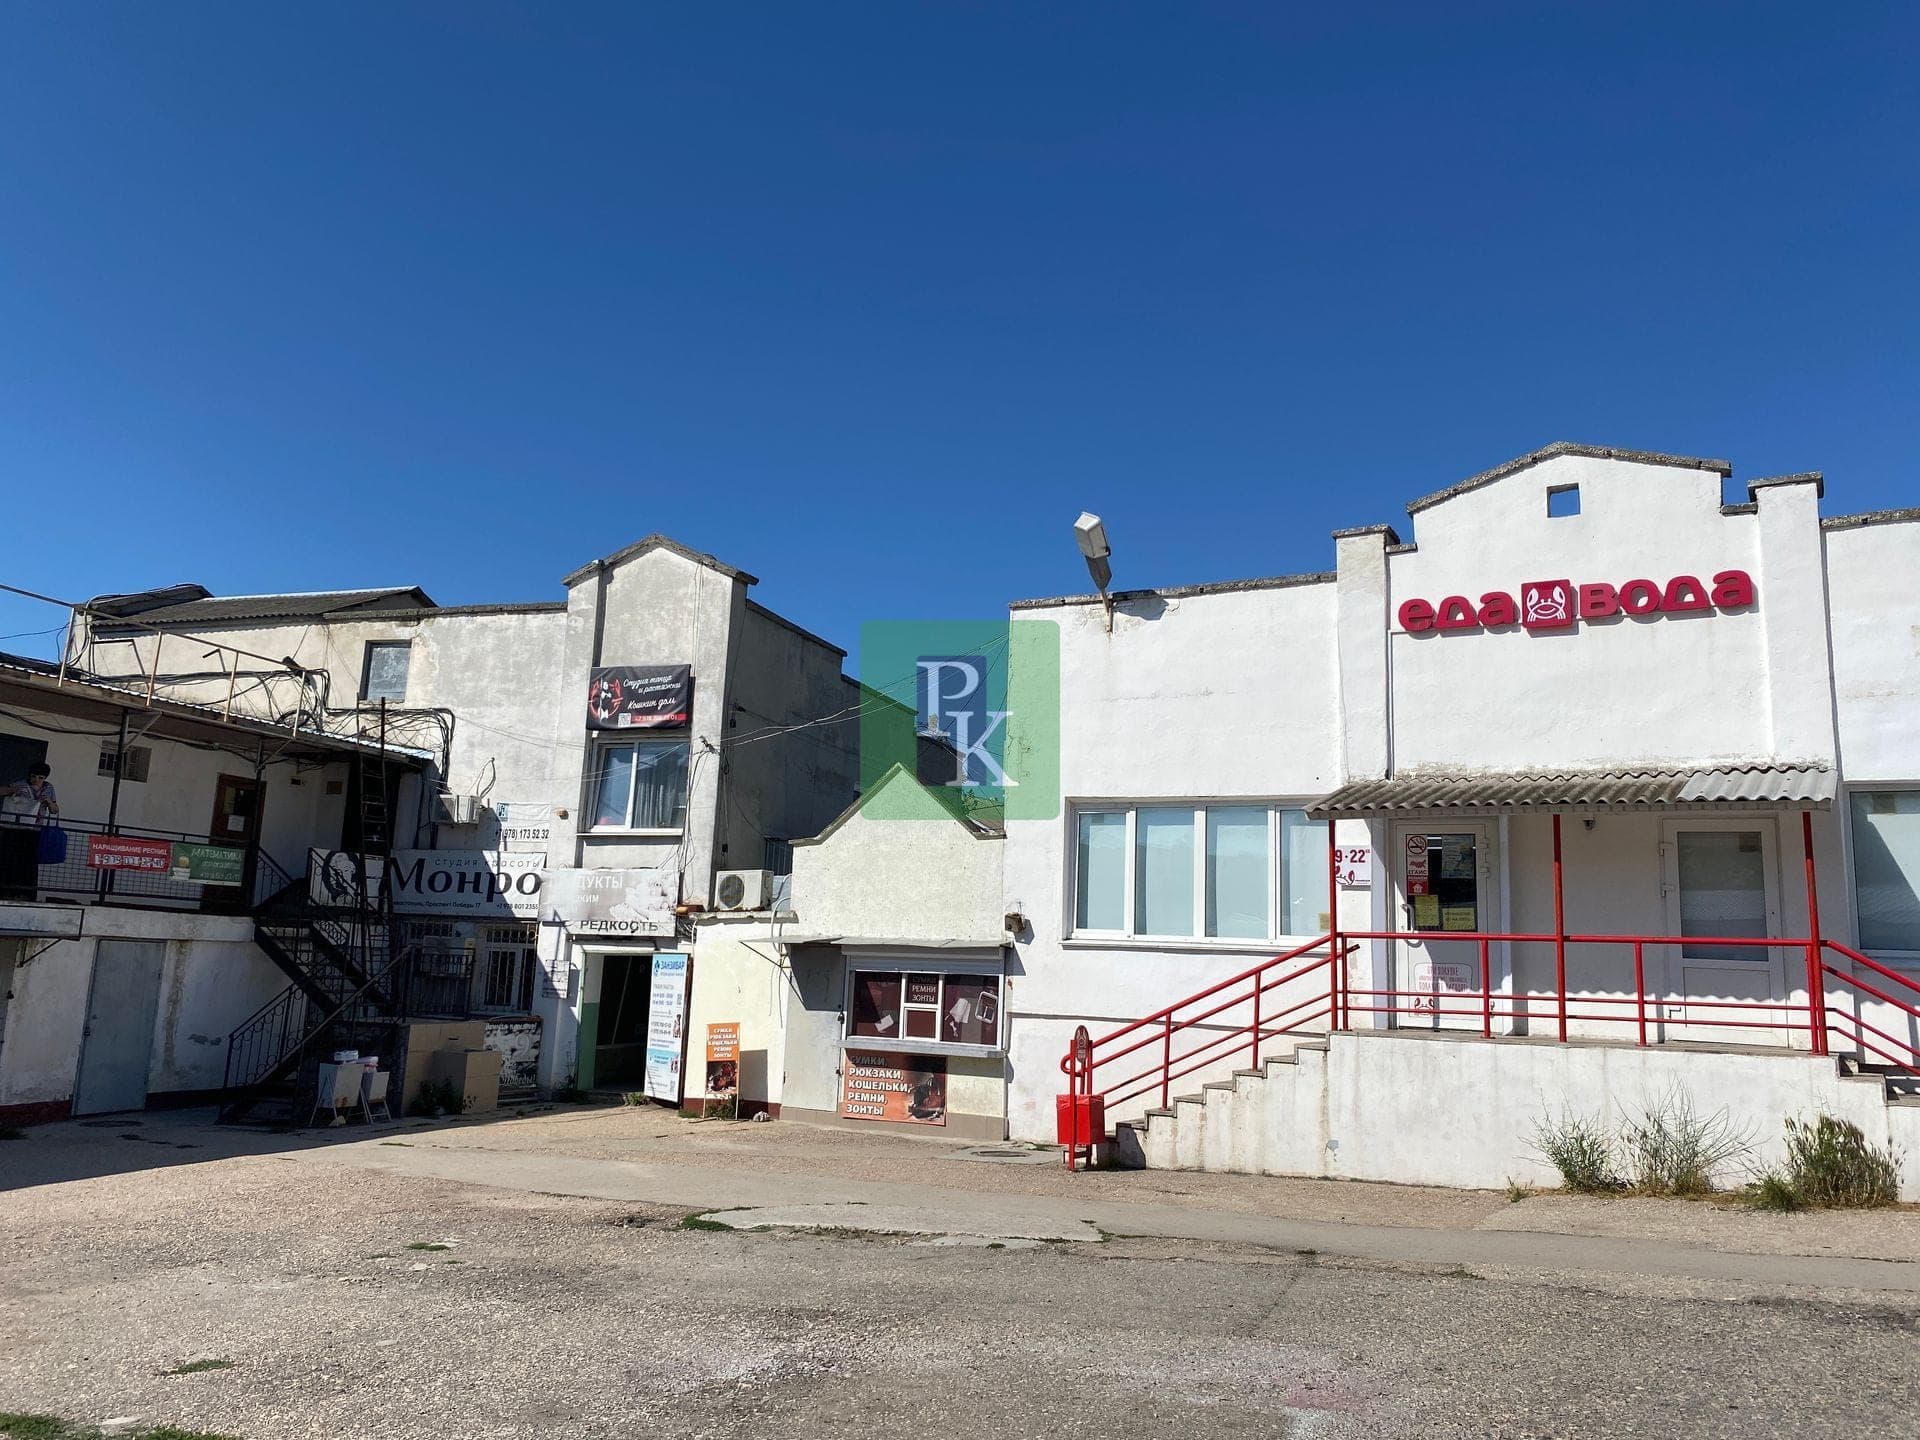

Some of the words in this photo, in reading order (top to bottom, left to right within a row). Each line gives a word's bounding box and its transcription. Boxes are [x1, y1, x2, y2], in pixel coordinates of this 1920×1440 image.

[1398, 591, 1515, 632] еда
[1579, 569, 1754, 618] вода
[623, 677, 649, 690] Студия
[649, 675, 673, 684] танца
[643, 682, 682, 695] растяжки
[627, 700, 658, 710] Кошкин
[657, 697, 676, 711] дом
[519, 828, 531, 840] 173
[532, 829, 541, 840] 52
[541, 829, 550, 840] 32
[435, 858, 478, 869] студия
[485, 859, 541, 869] красоты
[388, 857, 542, 903] Монро
[579, 919, 660, 933] РЕДКОСТЬ
[911, 984, 937, 994] РЕМНИ
[911, 993, 935, 1002] ЗОНТЫ
[850, 1055, 888, 1067] СУМКИ,
[849, 1067, 904, 1081] РЮКЗАКИ,
[848, 1079, 913, 1094] КОШЕЛЬКИ,
[847, 1092, 888, 1105] РЕМНИ,
[846, 1105, 884, 1116] ЗОНТЫ
